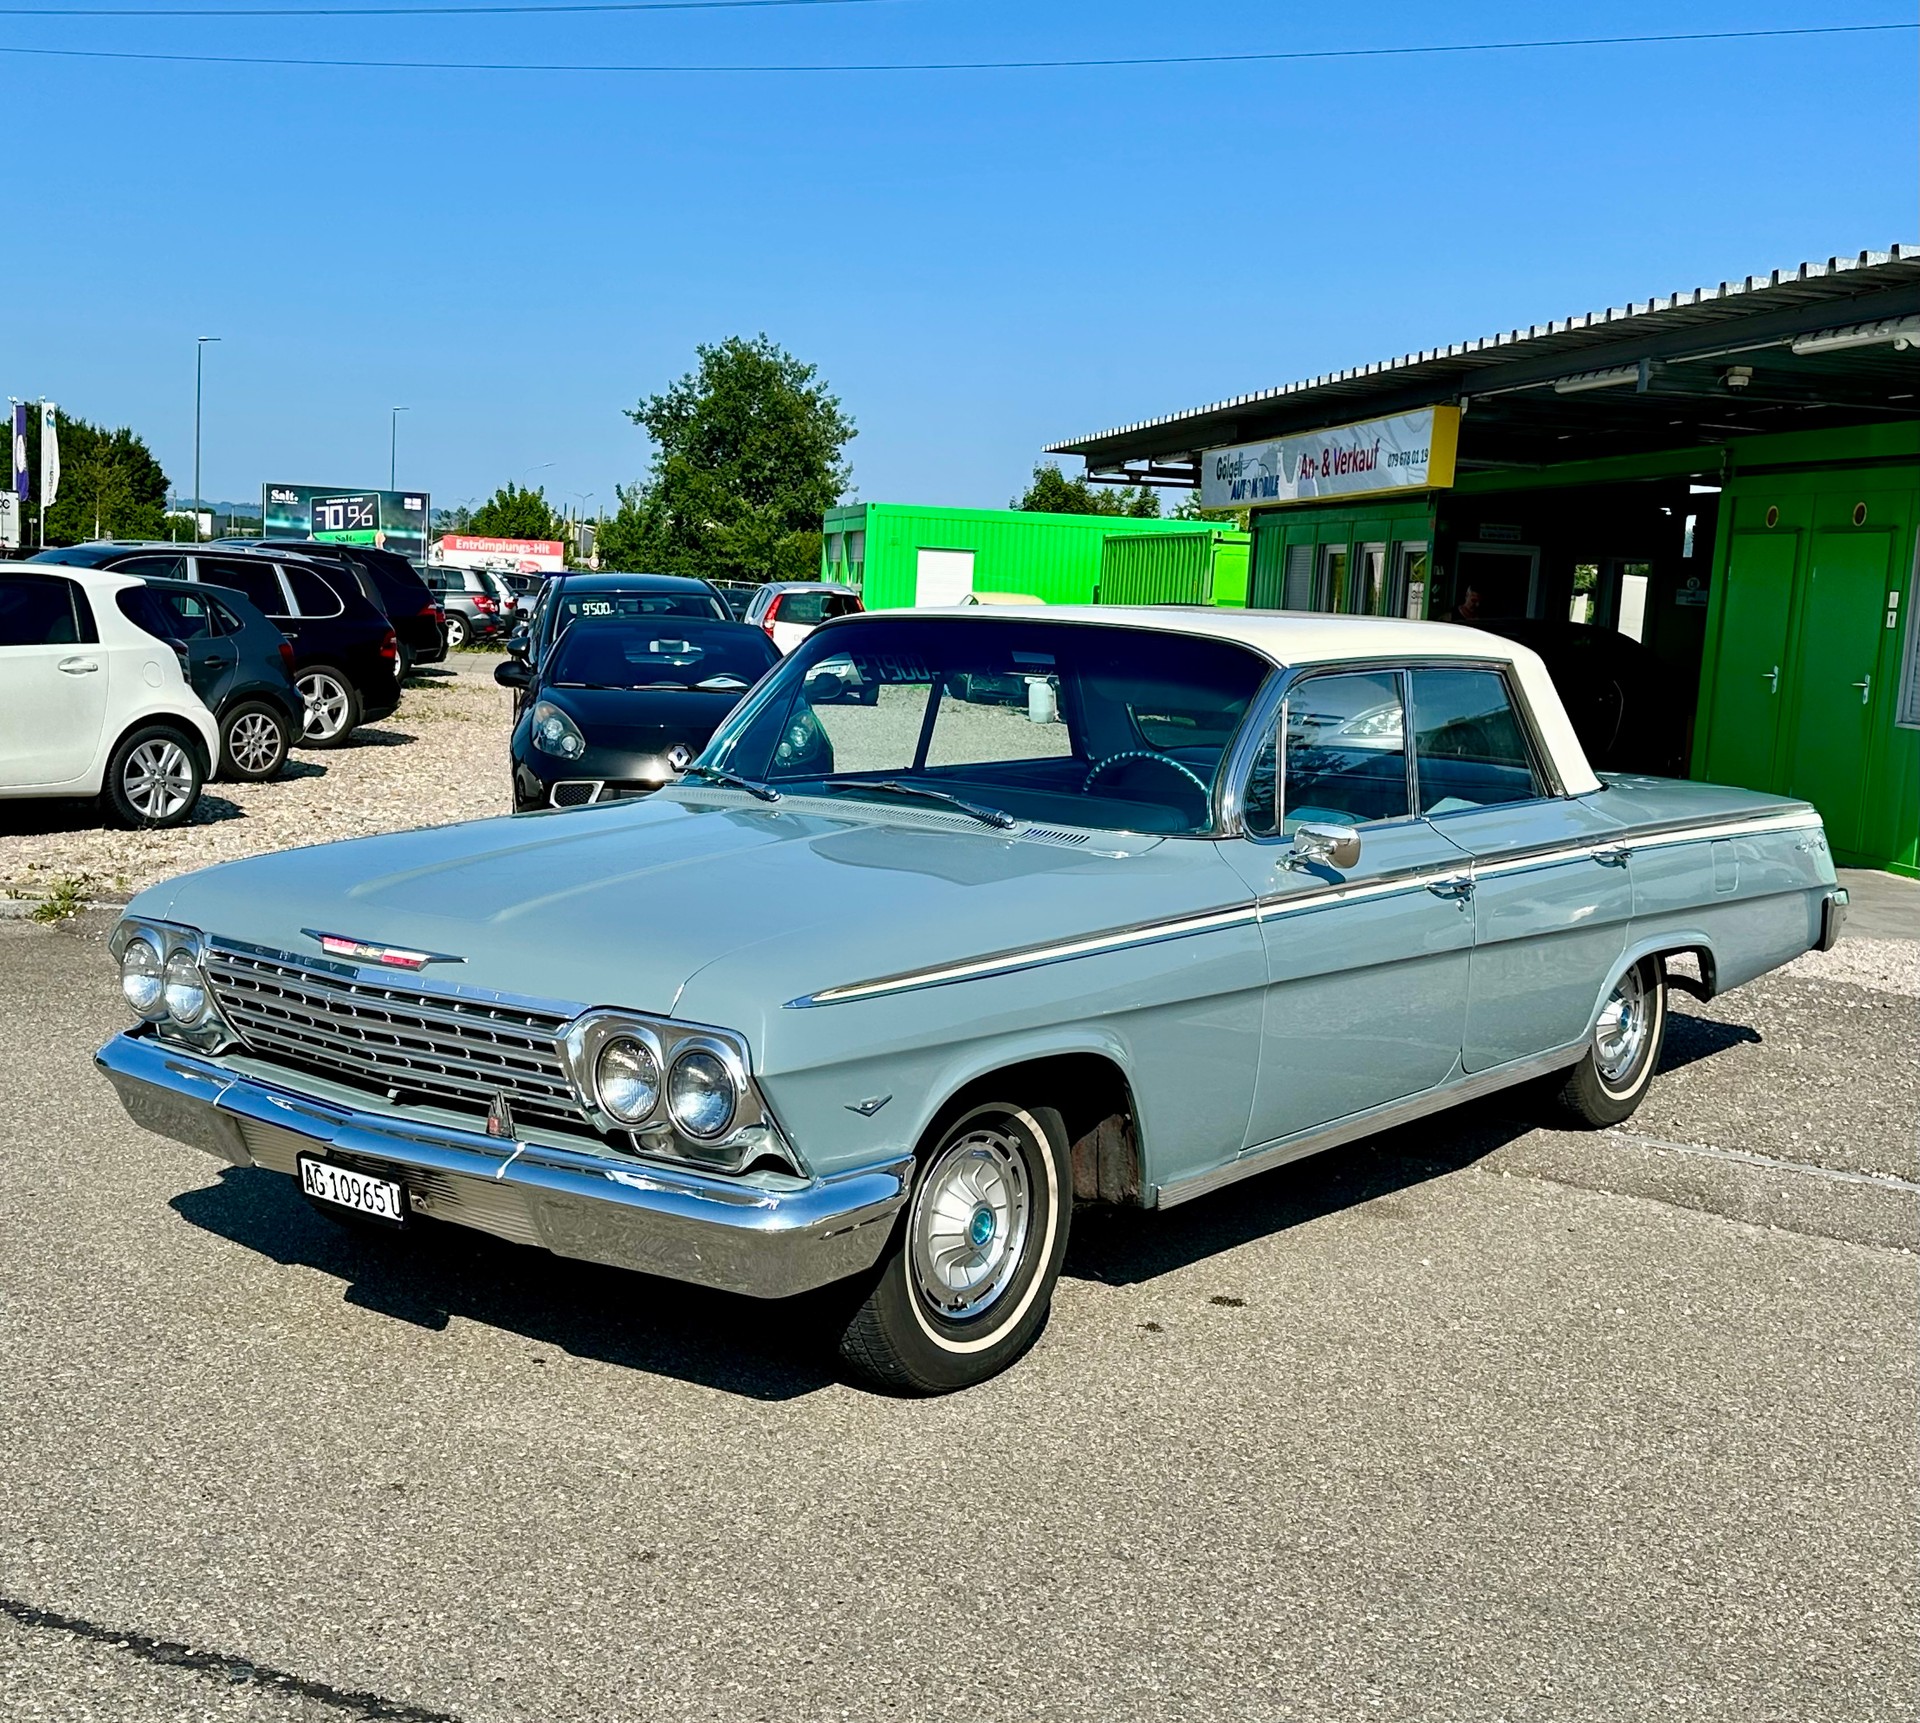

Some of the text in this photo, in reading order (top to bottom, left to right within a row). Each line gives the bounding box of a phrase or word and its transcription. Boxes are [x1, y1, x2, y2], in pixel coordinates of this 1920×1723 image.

[1321, 448, 1330, 478] &
[1333, 437, 1380, 476] Verkauf
[455, 539, 551, 555] Entrümplungs-Hit
